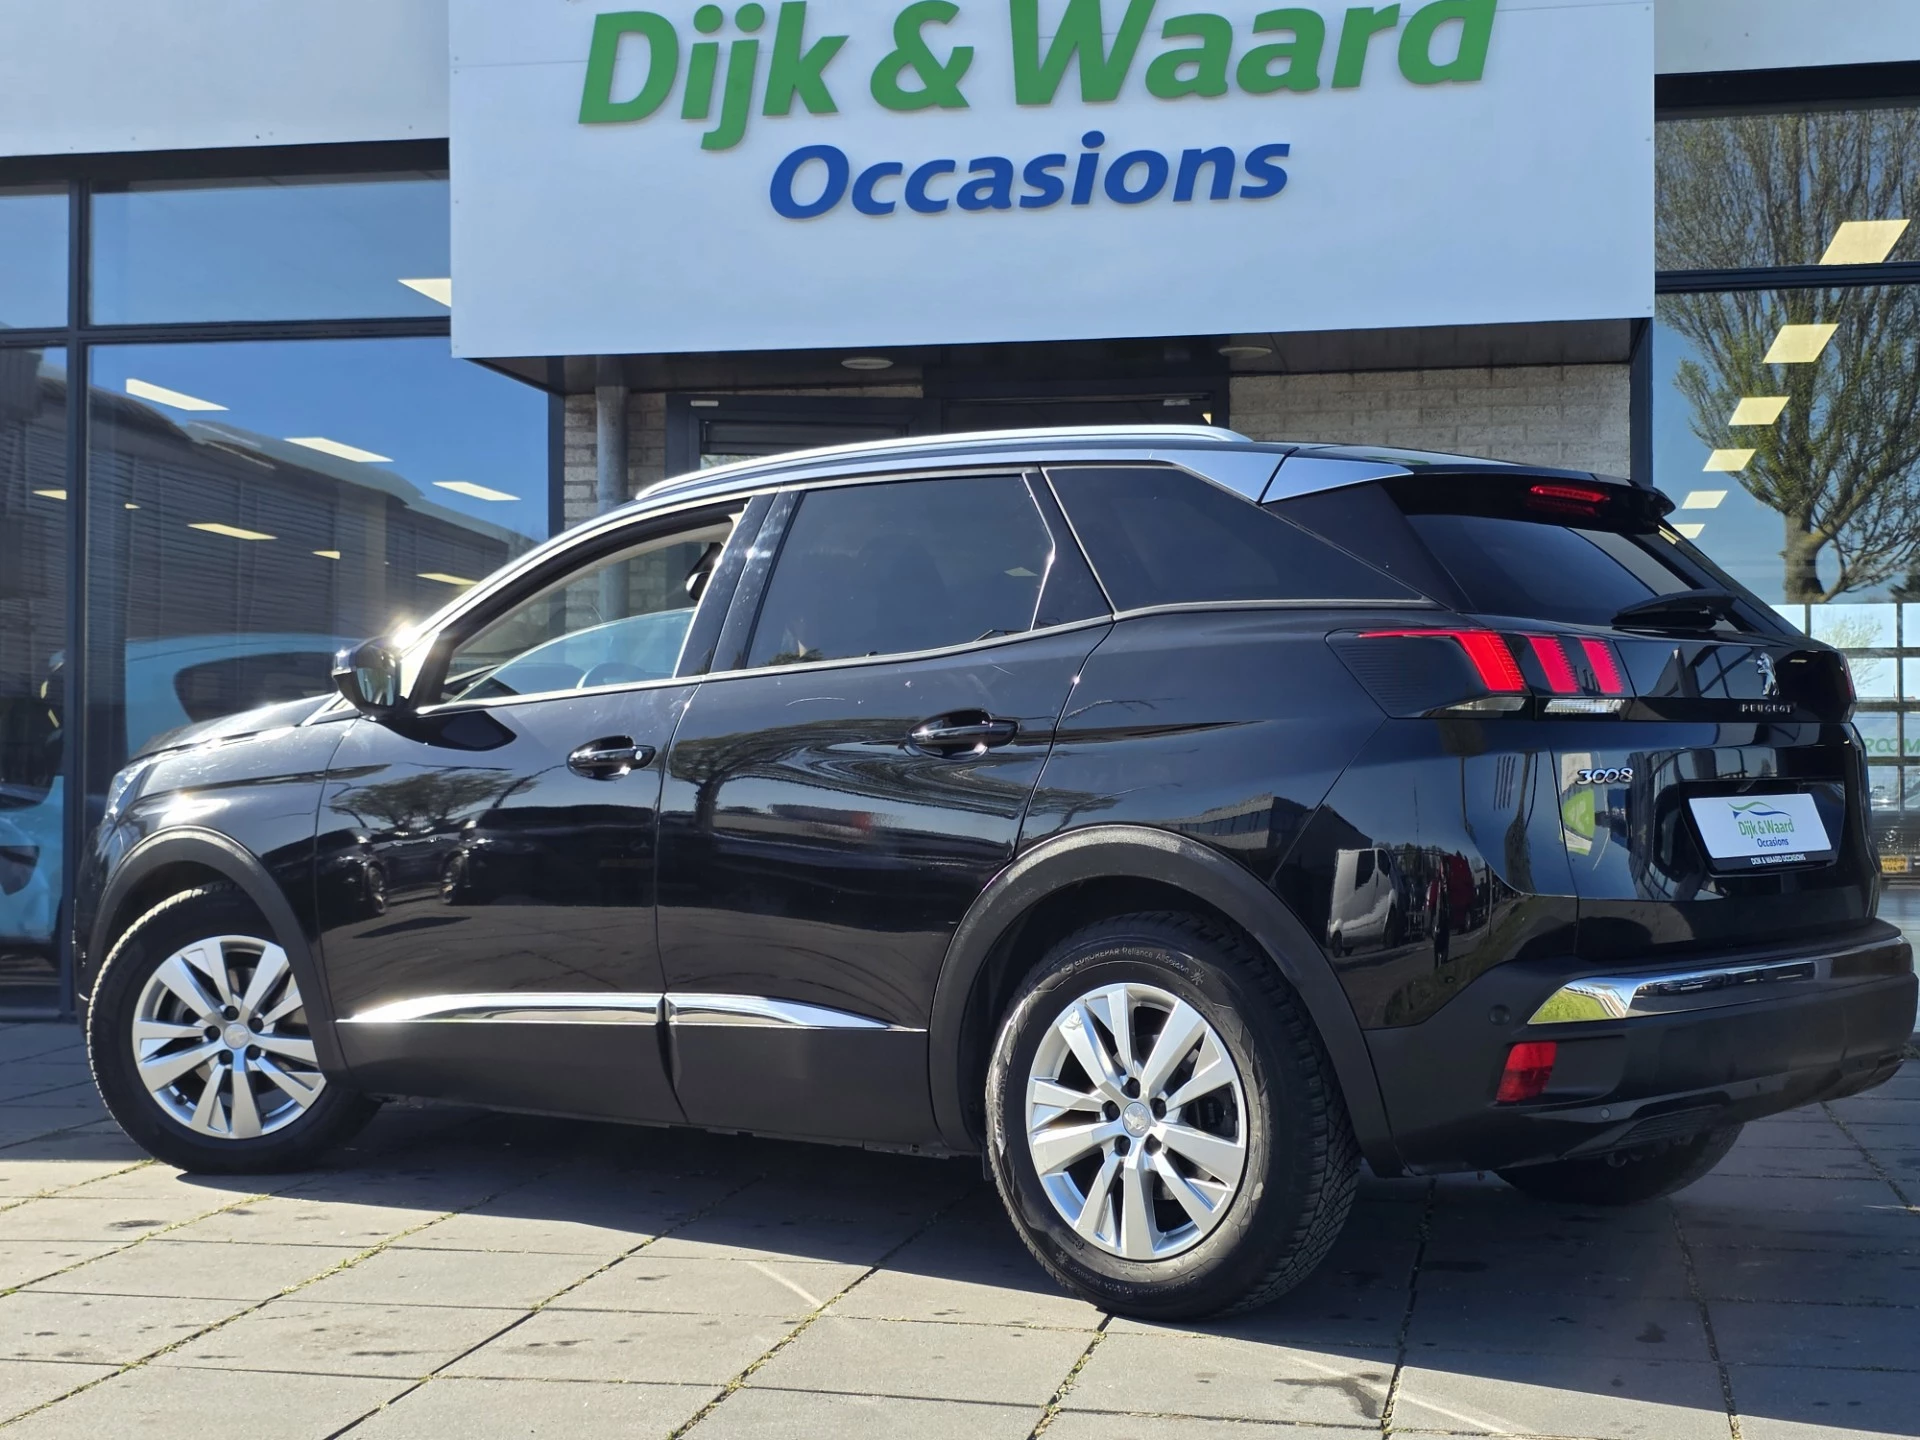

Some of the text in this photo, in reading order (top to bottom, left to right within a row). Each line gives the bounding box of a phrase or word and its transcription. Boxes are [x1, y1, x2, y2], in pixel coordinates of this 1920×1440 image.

[578, 0, 1498, 151] Dijk & Waard
[769, 131, 1290, 219] Occasions
[1741, 703, 1792, 713] PEUGEOT
[1576, 767, 1633, 785] 3008
[1738, 819, 1794, 839] Dijk & Waard
[1757, 837, 1789, 847] Occasions
[1121, 945, 1153, 958] Reliance
[1156, 953, 1190, 974] AllSeason
